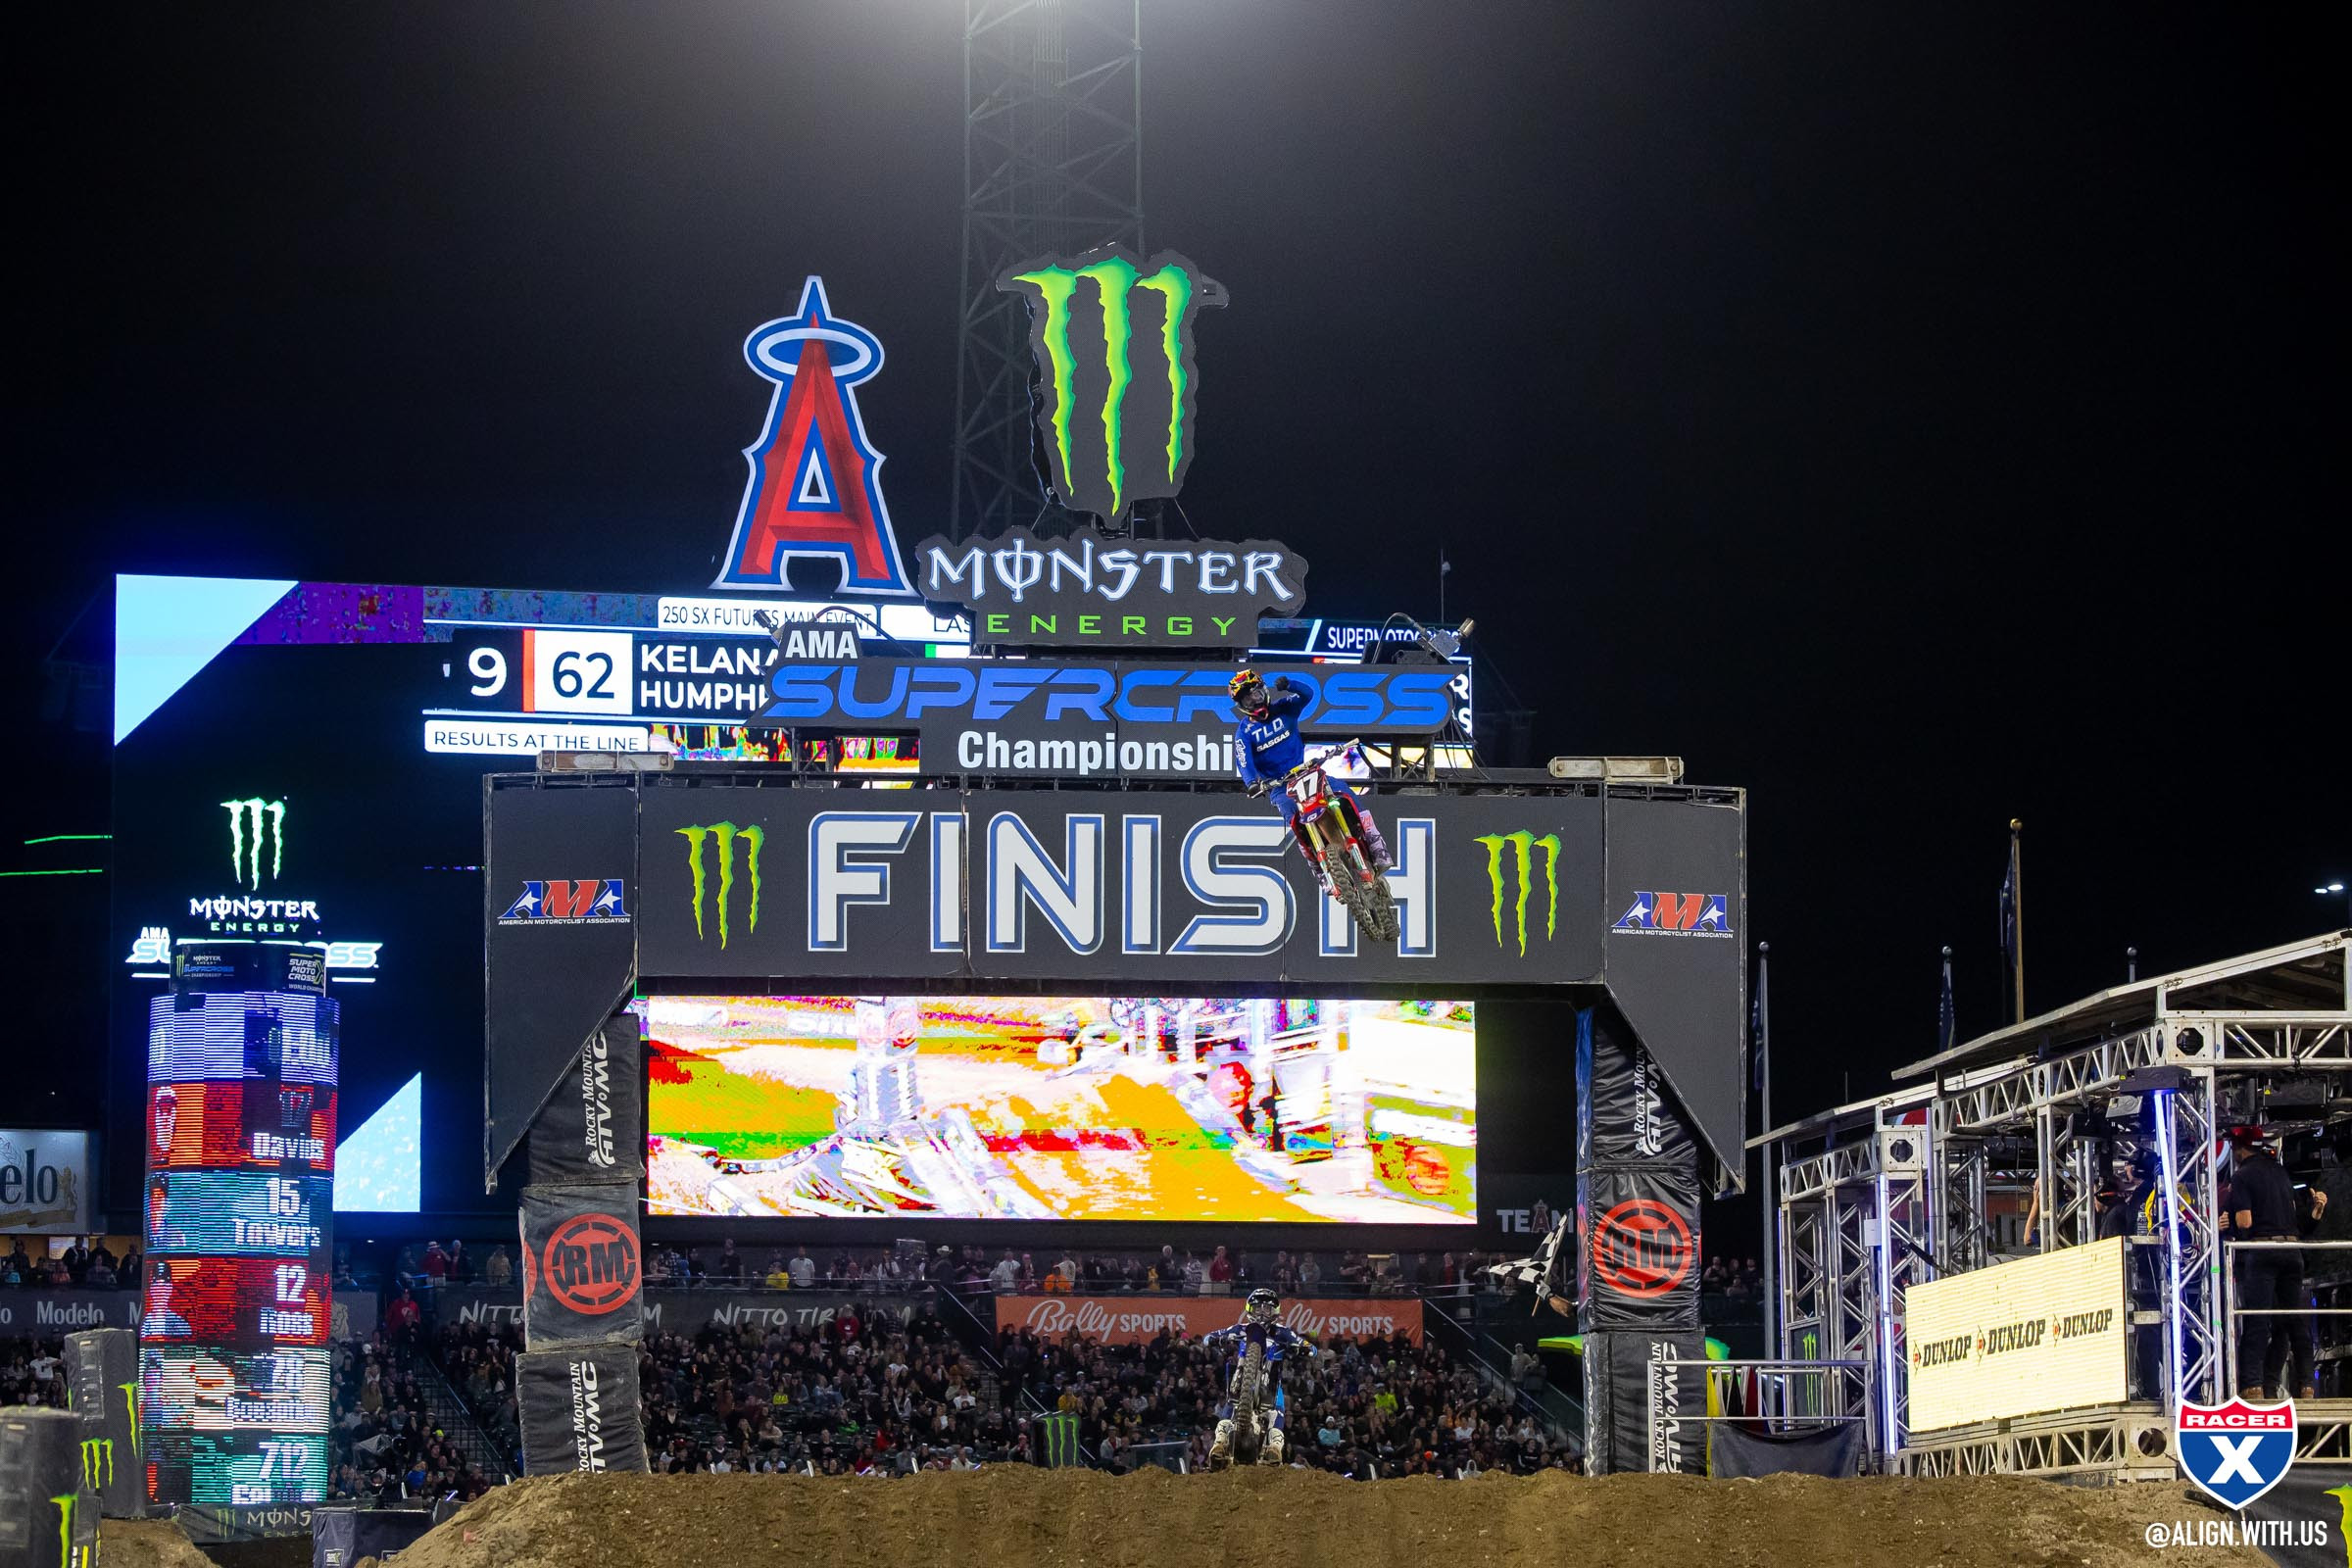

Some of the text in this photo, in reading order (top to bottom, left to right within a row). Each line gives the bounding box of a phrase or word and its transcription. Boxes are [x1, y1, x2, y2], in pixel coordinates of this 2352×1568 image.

[927, 538, 1294, 603] MONSTER
[663, 606, 688, 624] 250
[692, 607, 710, 624] SX
[987, 614, 1236, 636] ENERGY
[785, 630, 858, 659] AMA
[468, 648, 508, 697] 9
[553, 651, 614, 699] 62
[434, 731, 639, 752] RESULTS AT THE LINE
[957, 730, 1242, 777] Championshi
[1292, 770, 1319, 804] 17
[498, 879, 631, 919] AMA
[807, 811, 1438, 958] FINISH
[189, 895, 320, 922] MONSTER
[210, 922, 300, 933] ENERGY
[1611, 891, 1734, 932] AMA
[289, 958, 317, 967] SUPER
[291, 966, 316, 975] MOTO
[585, 1103, 597, 1148] ROCKY
[1634, 1090, 1645, 1135] ROCKY
[266, 1178, 301, 1216] 15
[232, 1218, 320, 1247] Towers
[1616, 1228, 1676, 1270] RM
[274, 1264, 307, 1301] 12
[563, 1241, 627, 1287] RM
[36, 1300, 105, 1324] Modelo
[713, 1301, 788, 1327] NITTO
[1027, 1299, 1186, 1343] Bally SPORTS
[1328, 1316, 1394, 1335] SPORTS
[1922, 1308, 2113, 1367] DUNLOP DUNLOP DUNLOP
[569, 1362, 586, 1434] MOUNTAIN
